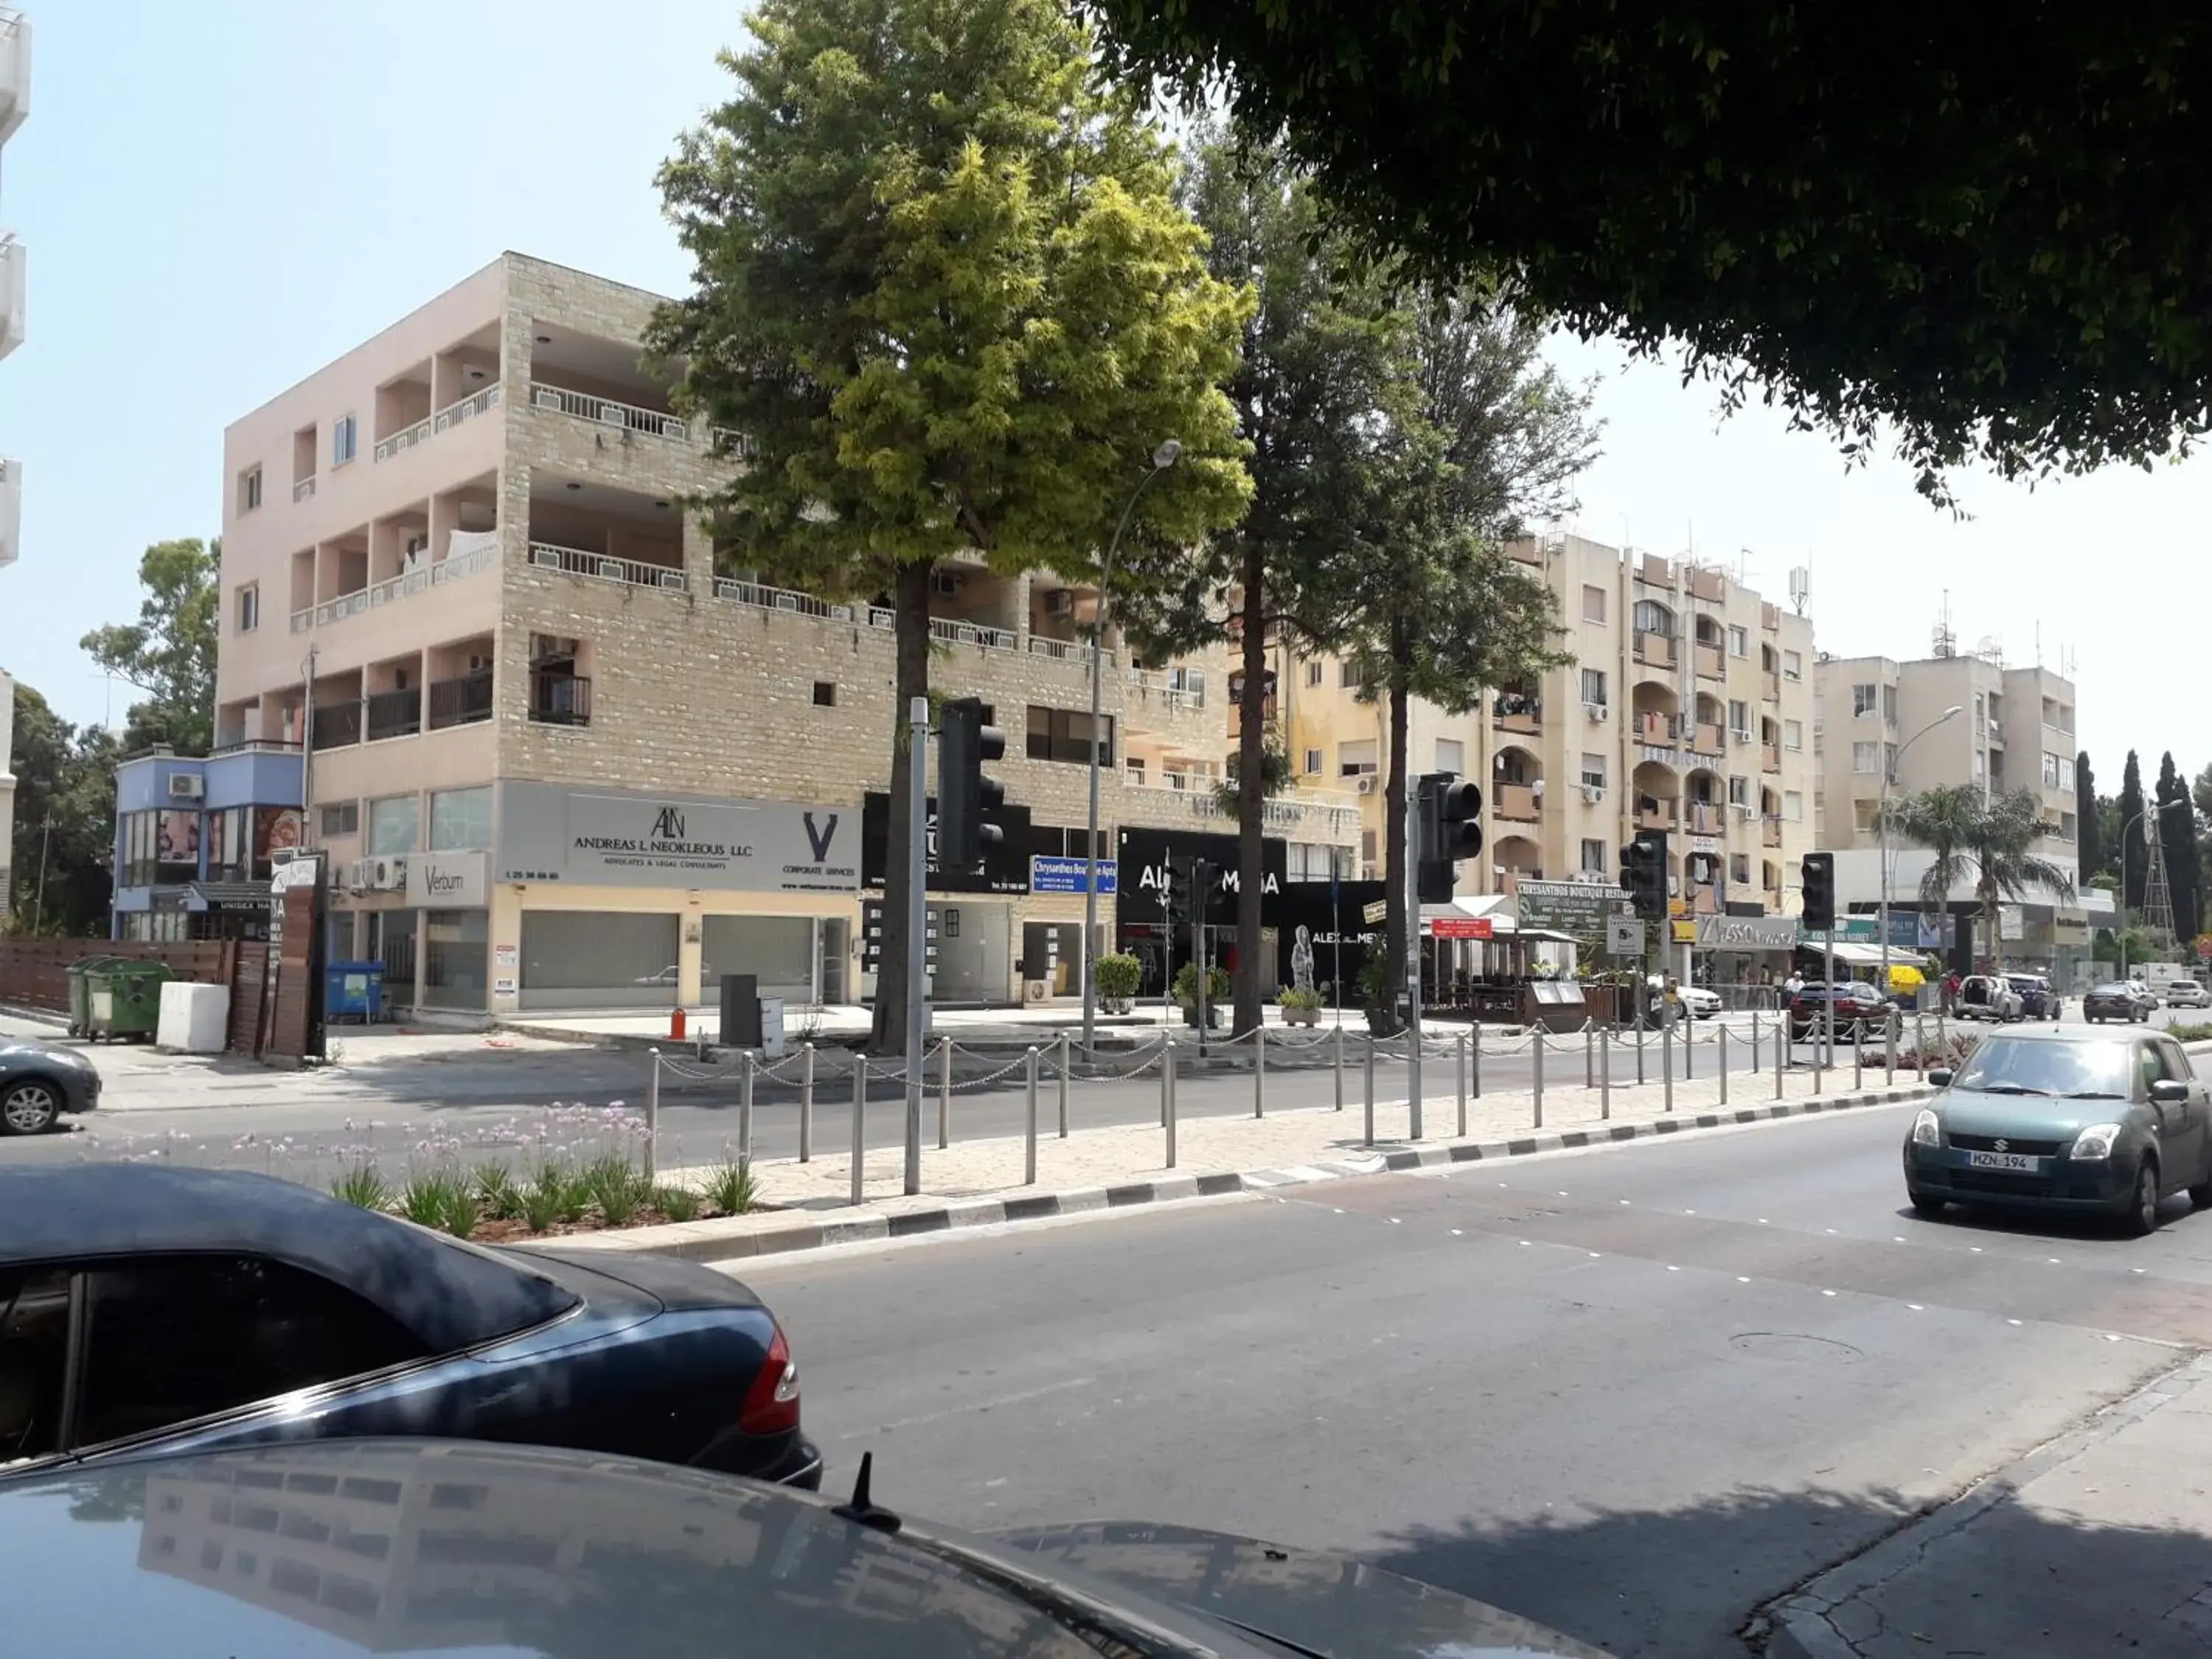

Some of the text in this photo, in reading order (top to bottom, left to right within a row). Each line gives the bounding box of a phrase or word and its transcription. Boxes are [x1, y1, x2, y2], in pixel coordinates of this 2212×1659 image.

[574, 837, 636, 851] ANDREAS
[650, 841, 725, 856] NEOKLEOUS
[731, 845, 754, 857] LLC
[603, 857, 644, 866] ADVOCATES
[655, 859, 677, 868] LEGAL
[680, 860, 726, 870] CONSULTANTS
[1035, 860, 1073, 874] Chrysanthos
[782, 865, 855, 877] CORPORATE SERVICES
[425, 864, 464, 897] Verbum
[1569, 886, 1603, 899] BOUTIQUE
[220, 901, 254, 910] UNISEX
[1312, 932, 1340, 944] ALEX
